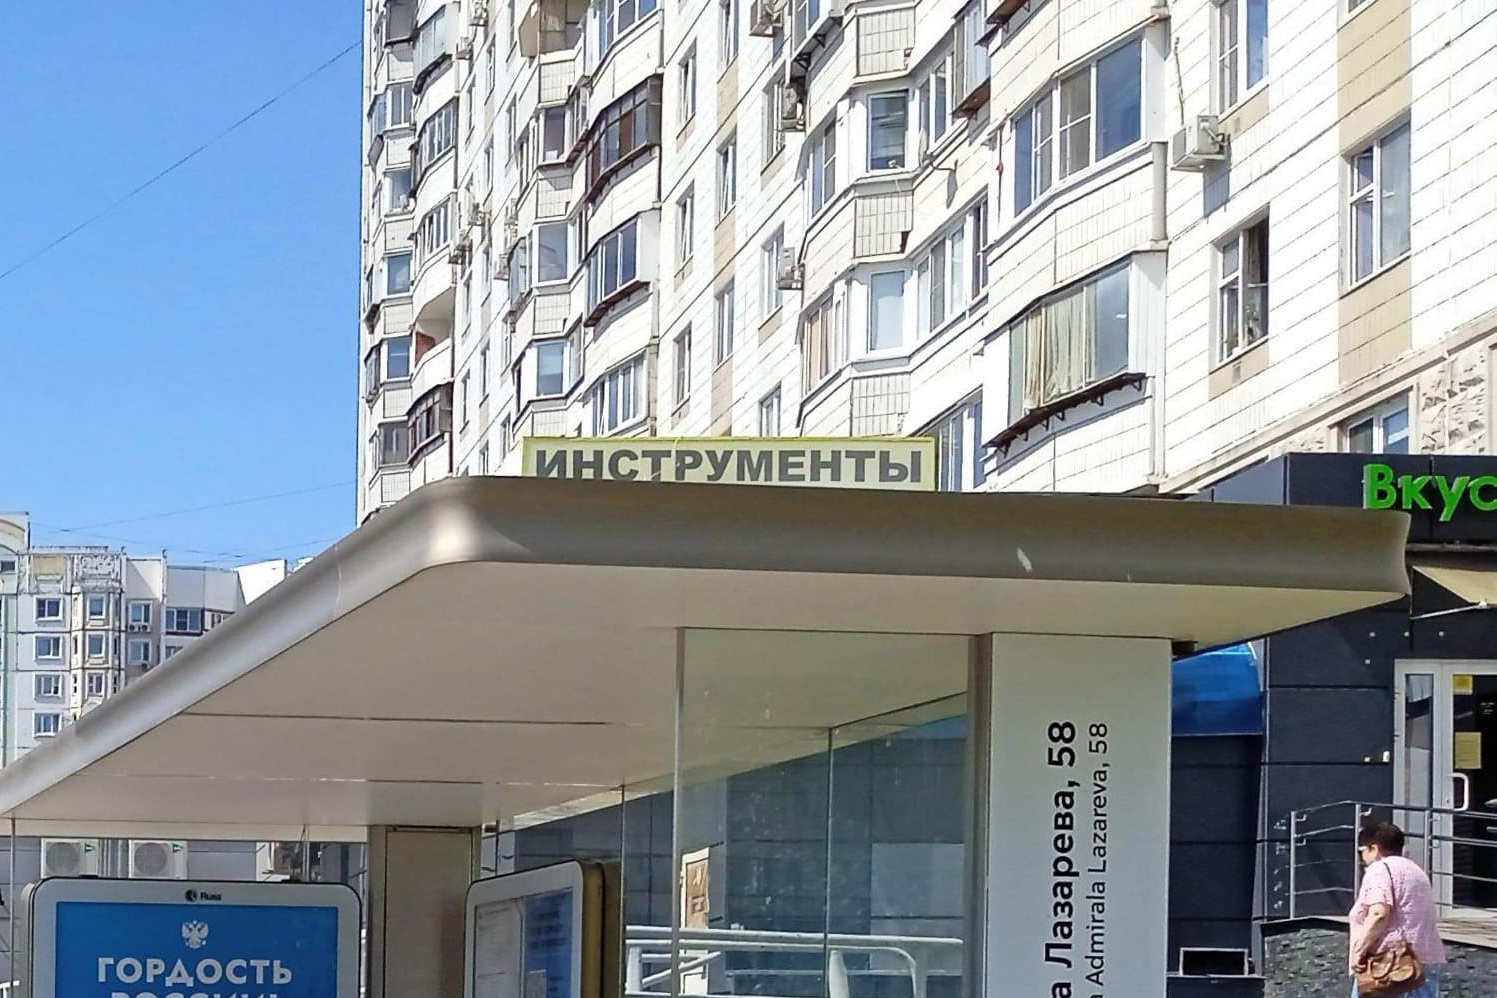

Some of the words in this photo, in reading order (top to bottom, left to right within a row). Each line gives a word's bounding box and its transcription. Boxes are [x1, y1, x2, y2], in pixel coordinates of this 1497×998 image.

[535, 448, 923, 483] ИНСТРУМЕНТЫ
[1047, 721, 1077, 768] 58
[1088, 722, 1108, 754] 58
[1087, 762, 1111, 874] Lazareva,
[1044, 780, 1081, 969] Лазарева,
[1084, 881, 1107, 987] Admirala
[97, 956, 293, 988] ГОРДОСТЬ
